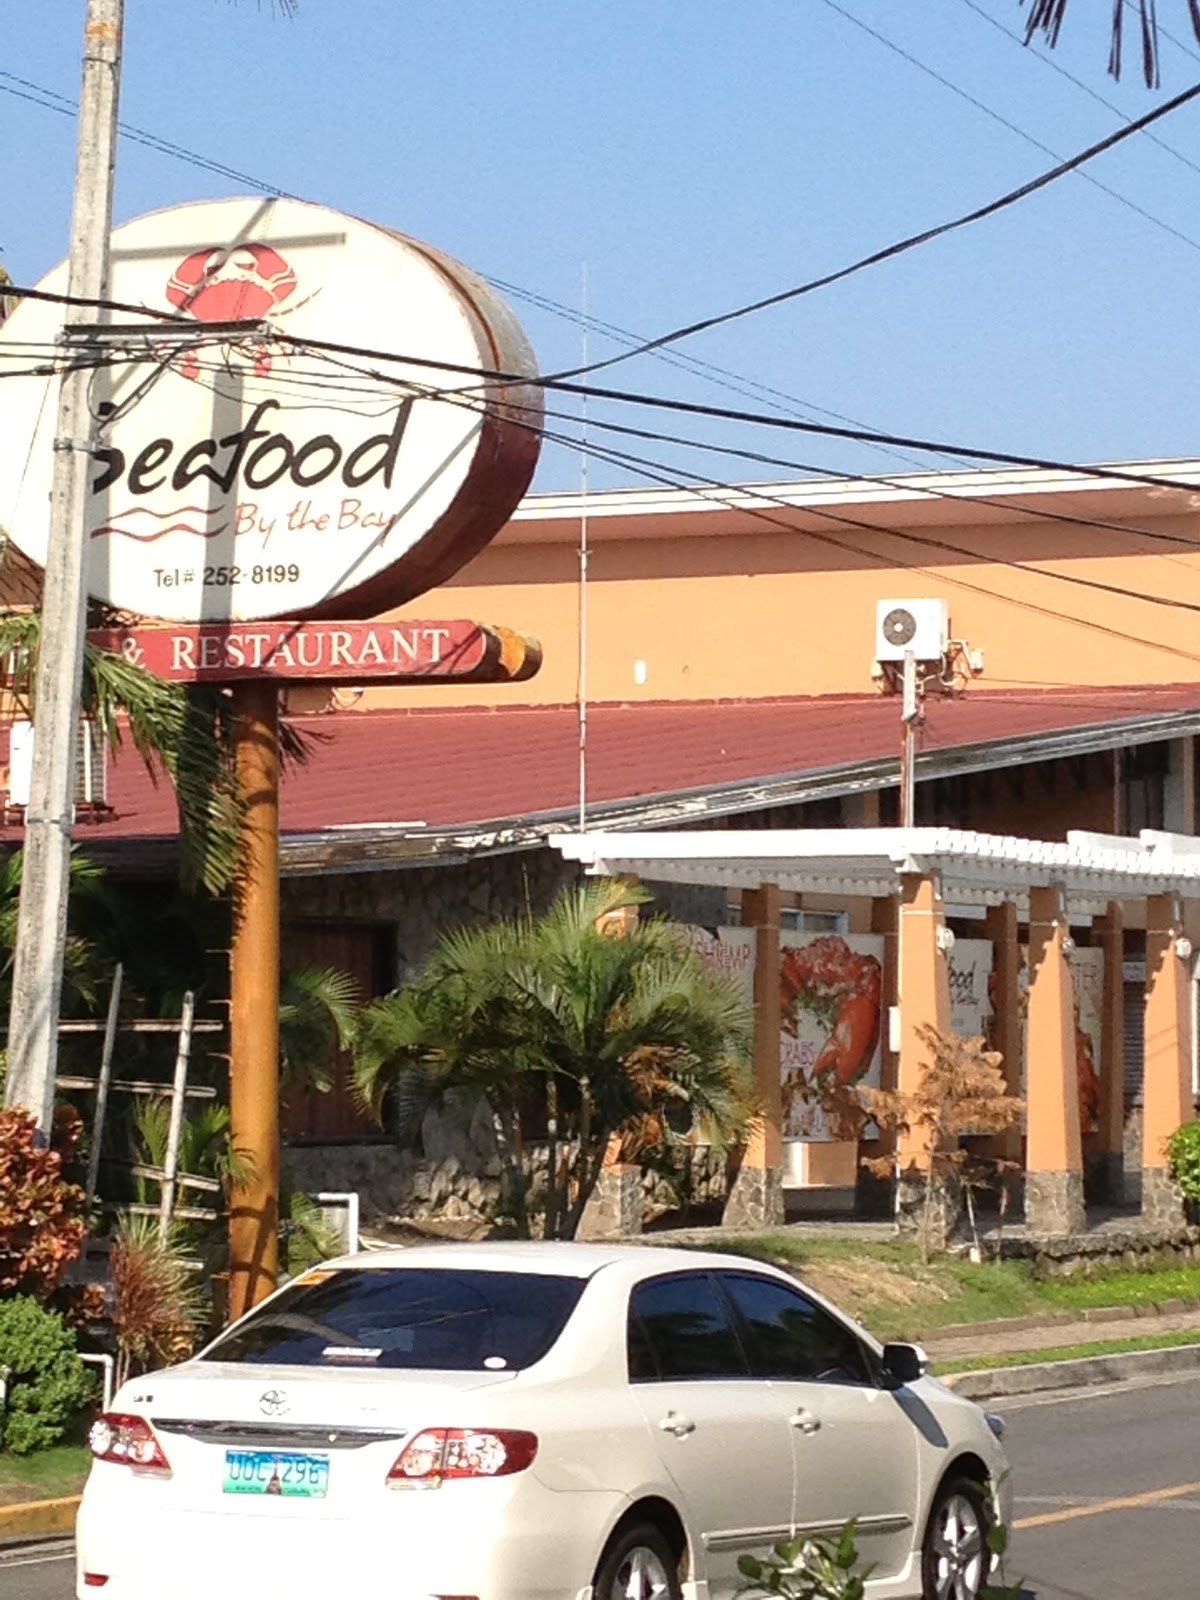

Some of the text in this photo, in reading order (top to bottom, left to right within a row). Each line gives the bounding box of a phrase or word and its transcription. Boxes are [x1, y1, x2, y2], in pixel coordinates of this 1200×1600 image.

[235, 498, 398, 550] By the Bay
[203, 564, 300, 587] 252-8199
[121, 628, 450, 671] & RESTAURANT
